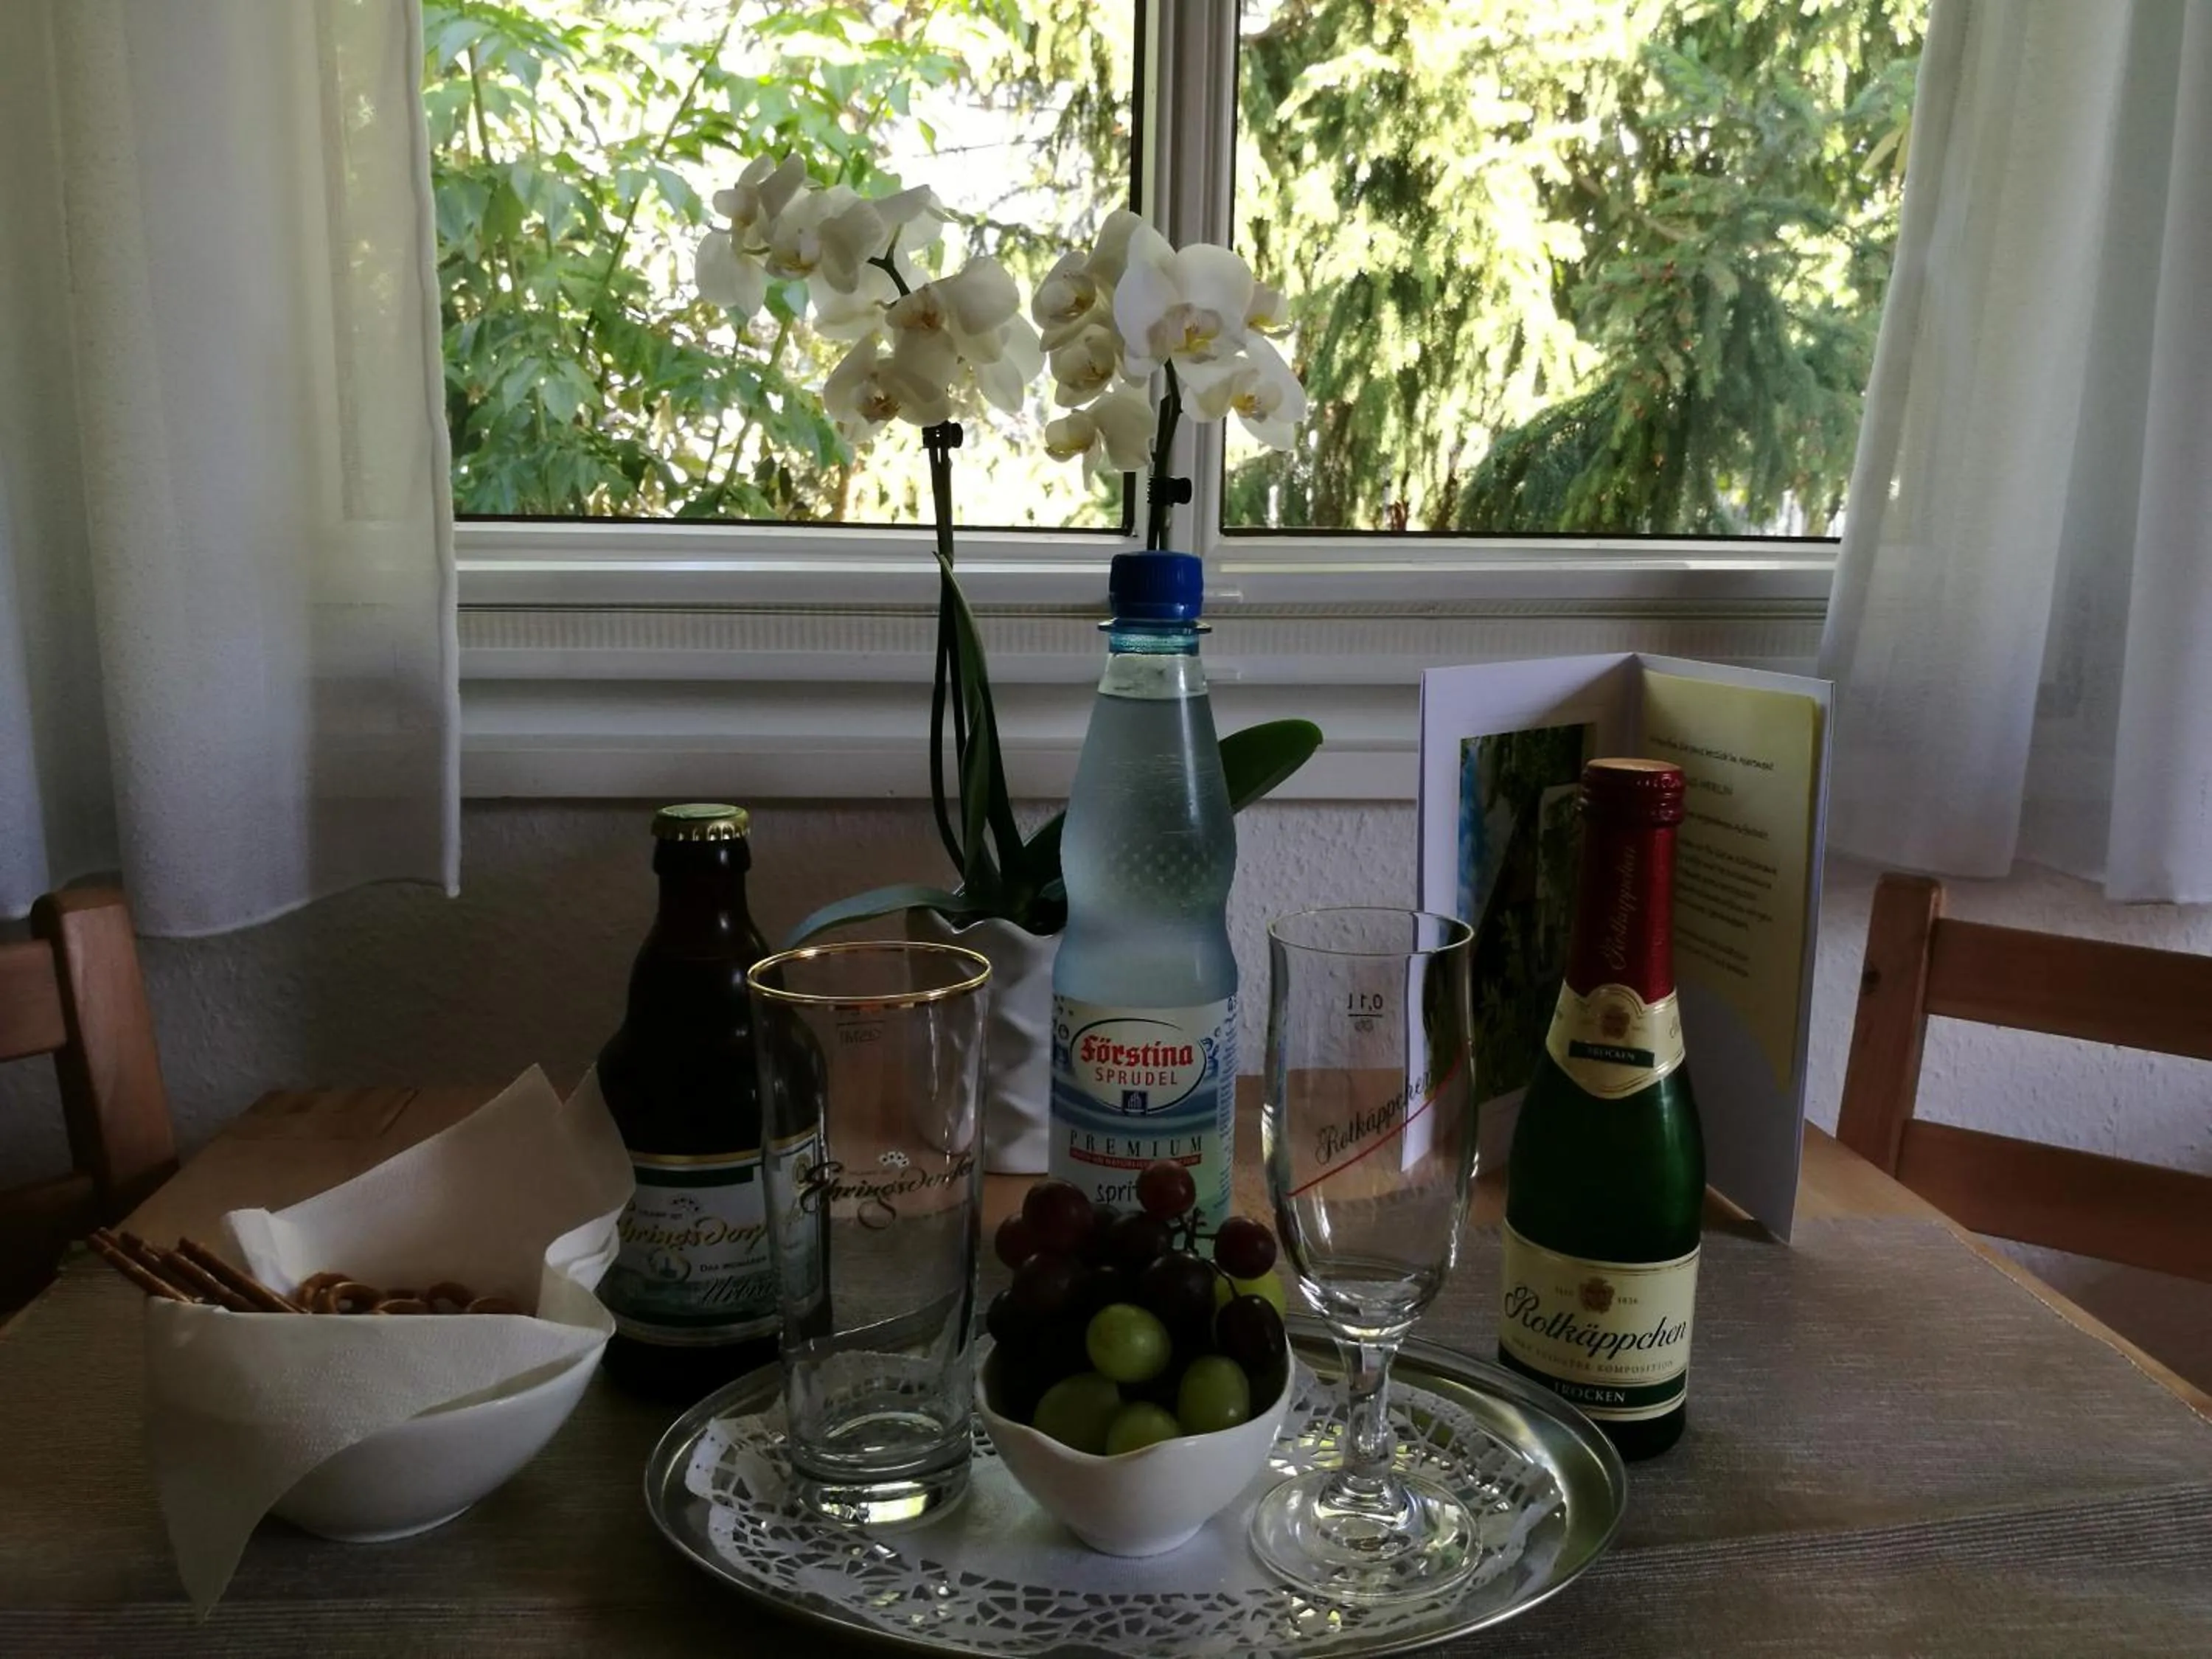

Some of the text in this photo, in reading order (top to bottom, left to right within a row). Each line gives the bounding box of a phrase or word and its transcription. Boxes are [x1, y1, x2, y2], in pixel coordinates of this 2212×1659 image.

[1079, 1034, 1194, 1068] Förstina
[1095, 1067, 1178, 1086] SPRUDEL
[1069, 1129, 1203, 1157] PREMIUM
[1504, 1286, 1687, 1360] Rotkäppchen
[1554, 1380, 1627, 1404] TROCKEN
